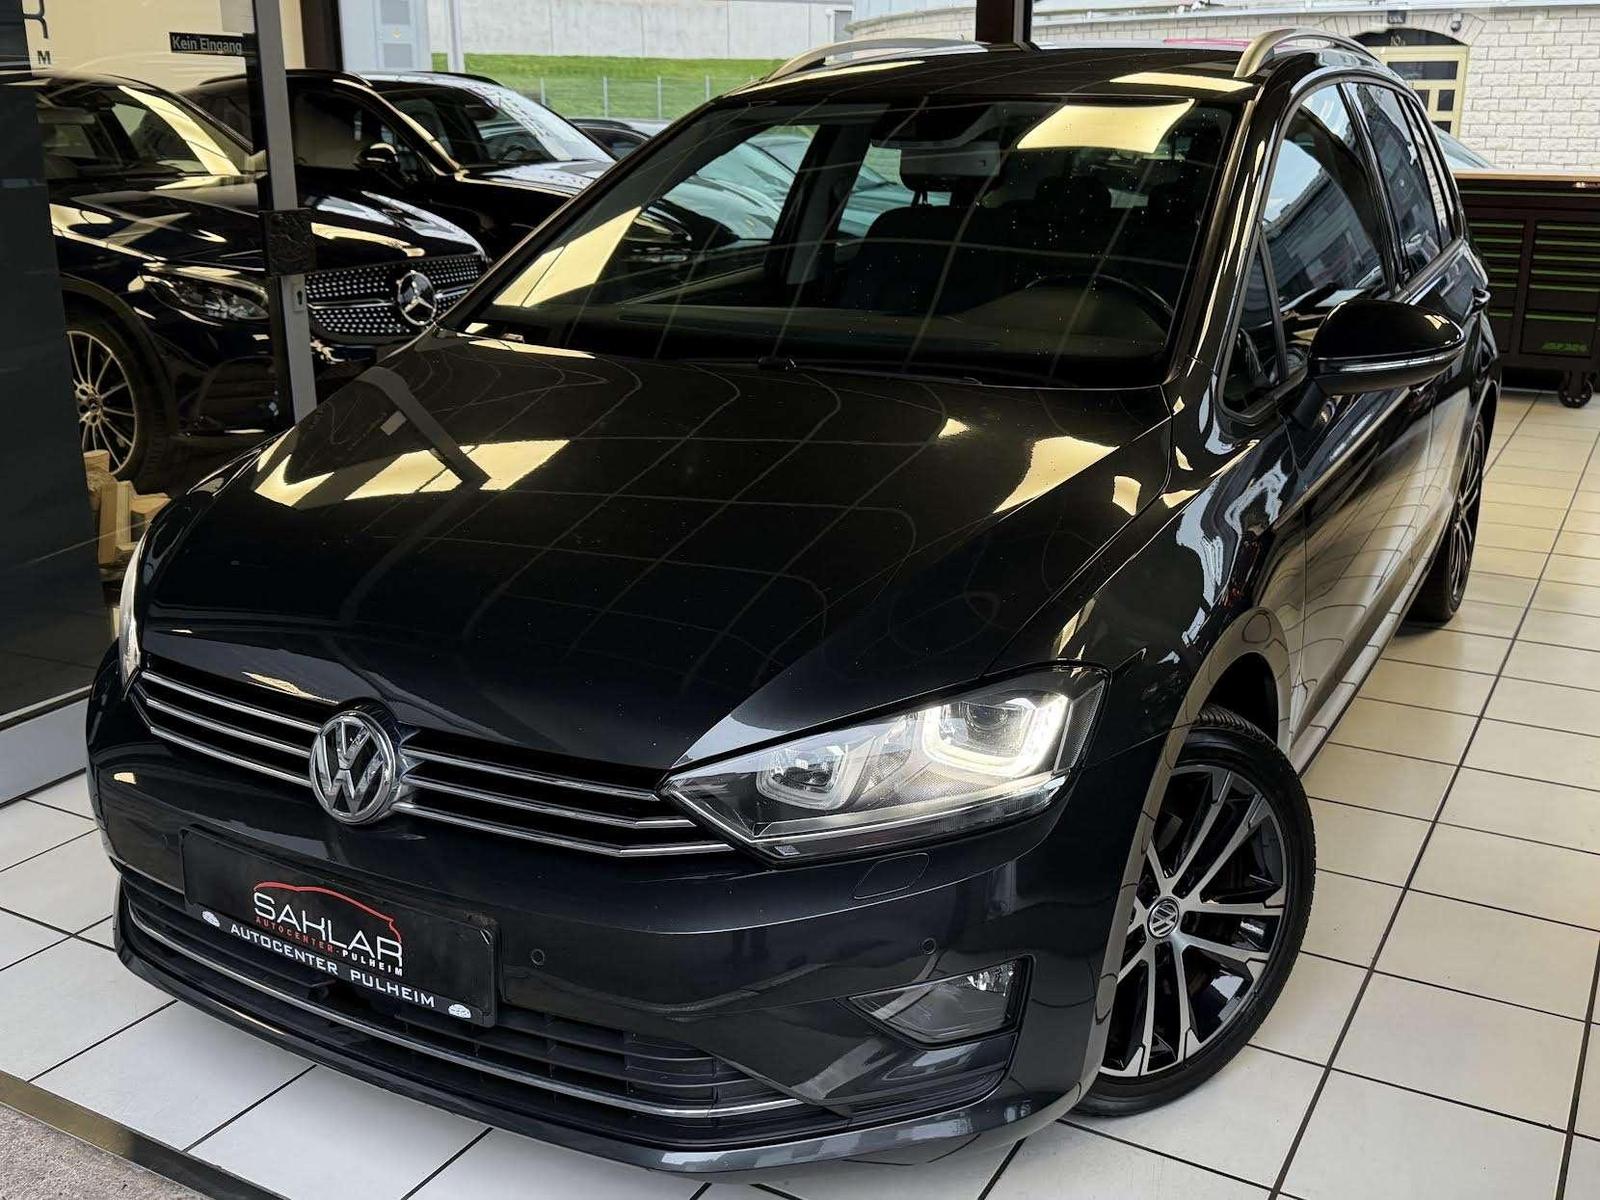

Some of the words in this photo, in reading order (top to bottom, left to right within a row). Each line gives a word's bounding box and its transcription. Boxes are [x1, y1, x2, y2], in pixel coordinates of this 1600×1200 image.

[171, 34, 199, 51] Kein
[199, 37, 243, 56] Eingang
[230, 923, 339, 977] AUTOCENTER
[349, 968, 436, 1009] PULHEIM
[253, 891, 403, 968] SAHLAR
